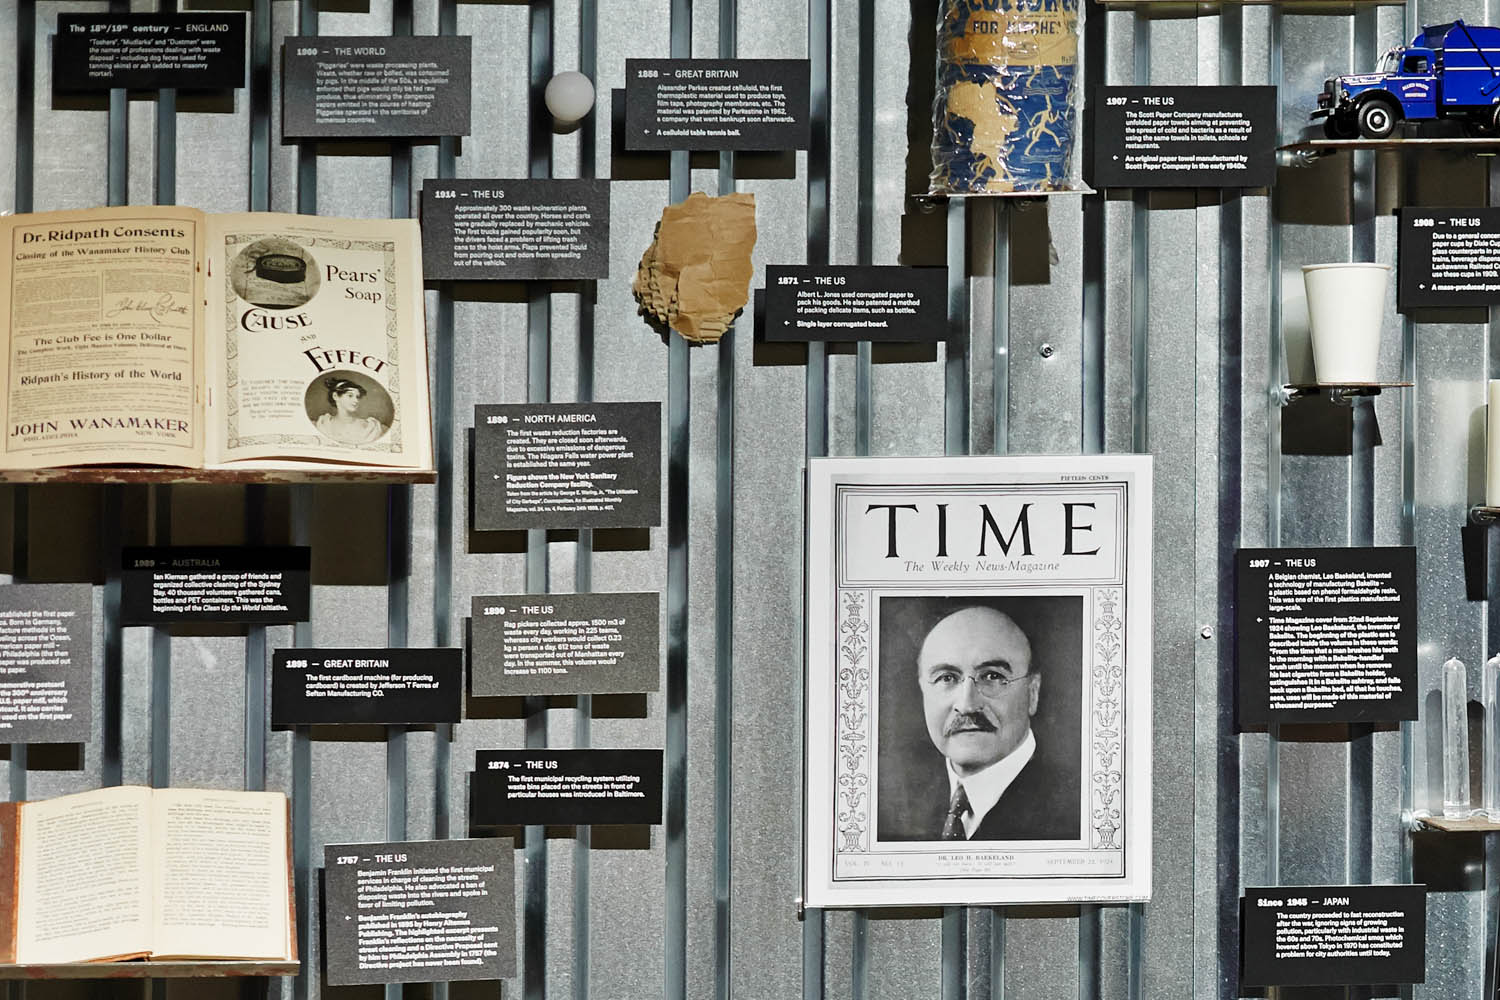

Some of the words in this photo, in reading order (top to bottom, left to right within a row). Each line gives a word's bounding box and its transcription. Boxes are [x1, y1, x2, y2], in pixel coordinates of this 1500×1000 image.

[69, 24, 86, 32] The
[132, 25, 169, 34] century
[186, 24, 229, 32] ENGLAND
[973, 20, 998, 35] FOR
[1106, 97, 1127, 105] 1907
[1143, 97, 1160, 105] THE
[1162, 97, 1174, 105] US
[435, 190, 456, 198] 1914
[472, 190, 490, 198] THE
[492, 190, 504, 199] US
[23, 232, 46, 244] Dr.
[48, 227, 110, 242] Ridpath
[113, 226, 185, 238] Consents
[49, 250, 58, 258] of
[61, 249, 74, 257] the
[77, 247, 131, 255] Wanamaker
[134, 246, 167, 255] History
[170, 246, 191, 256] Club
[326, 264, 382, 283] Pears'
[778, 277, 799, 285] 1871
[814, 277, 832, 285] THE
[833, 277, 846, 285] US
[344, 287, 382, 304] Soap
[240, 307, 313, 333] CAUSE
[33, 338, 52, 346] The
[56, 335, 80, 344] Club
[83, 334, 102, 342] Fee
[104, 333, 113, 341] is
[116, 332, 137, 341] One
[140, 332, 172, 342] Dollar
[303, 346, 389, 374] EFFECT
[21, 372, 69, 386] Ridpath's
[72, 370, 111, 381] History
[114, 369, 125, 378] of
[129, 369, 146, 378] the
[150, 369, 182, 381] World
[524, 414, 555, 423] NORTH
[557, 414, 597, 423] AMERICA
[10, 421, 59, 437] JOHN
[69, 417, 189, 433] WANAMAKER
[866, 502, 1101, 560] TIME
[172, 559, 220, 567] AUSTRALIA
[903, 560, 925, 572] The
[931, 560, 970, 574] Weekly
[975, 560, 1060, 574] News-Magazine
[1249, 559, 1270, 568] 1907
[1285, 559, 1302, 567] THE
[1304, 559, 1316, 567] US
[324, 659, 353, 668] GREAT
[355, 659, 389, 668] BRITAIN
[488, 761, 509, 769] 1874
[526, 761, 543, 769] THE
[545, 761, 558, 769] US
[375, 854, 393, 863] THE
[395, 854, 407, 862] US
[1257, 898, 1283, 907] Since
[1287, 898, 1307, 906] 1945
[1323, 897, 1349, 906] JAPAN
